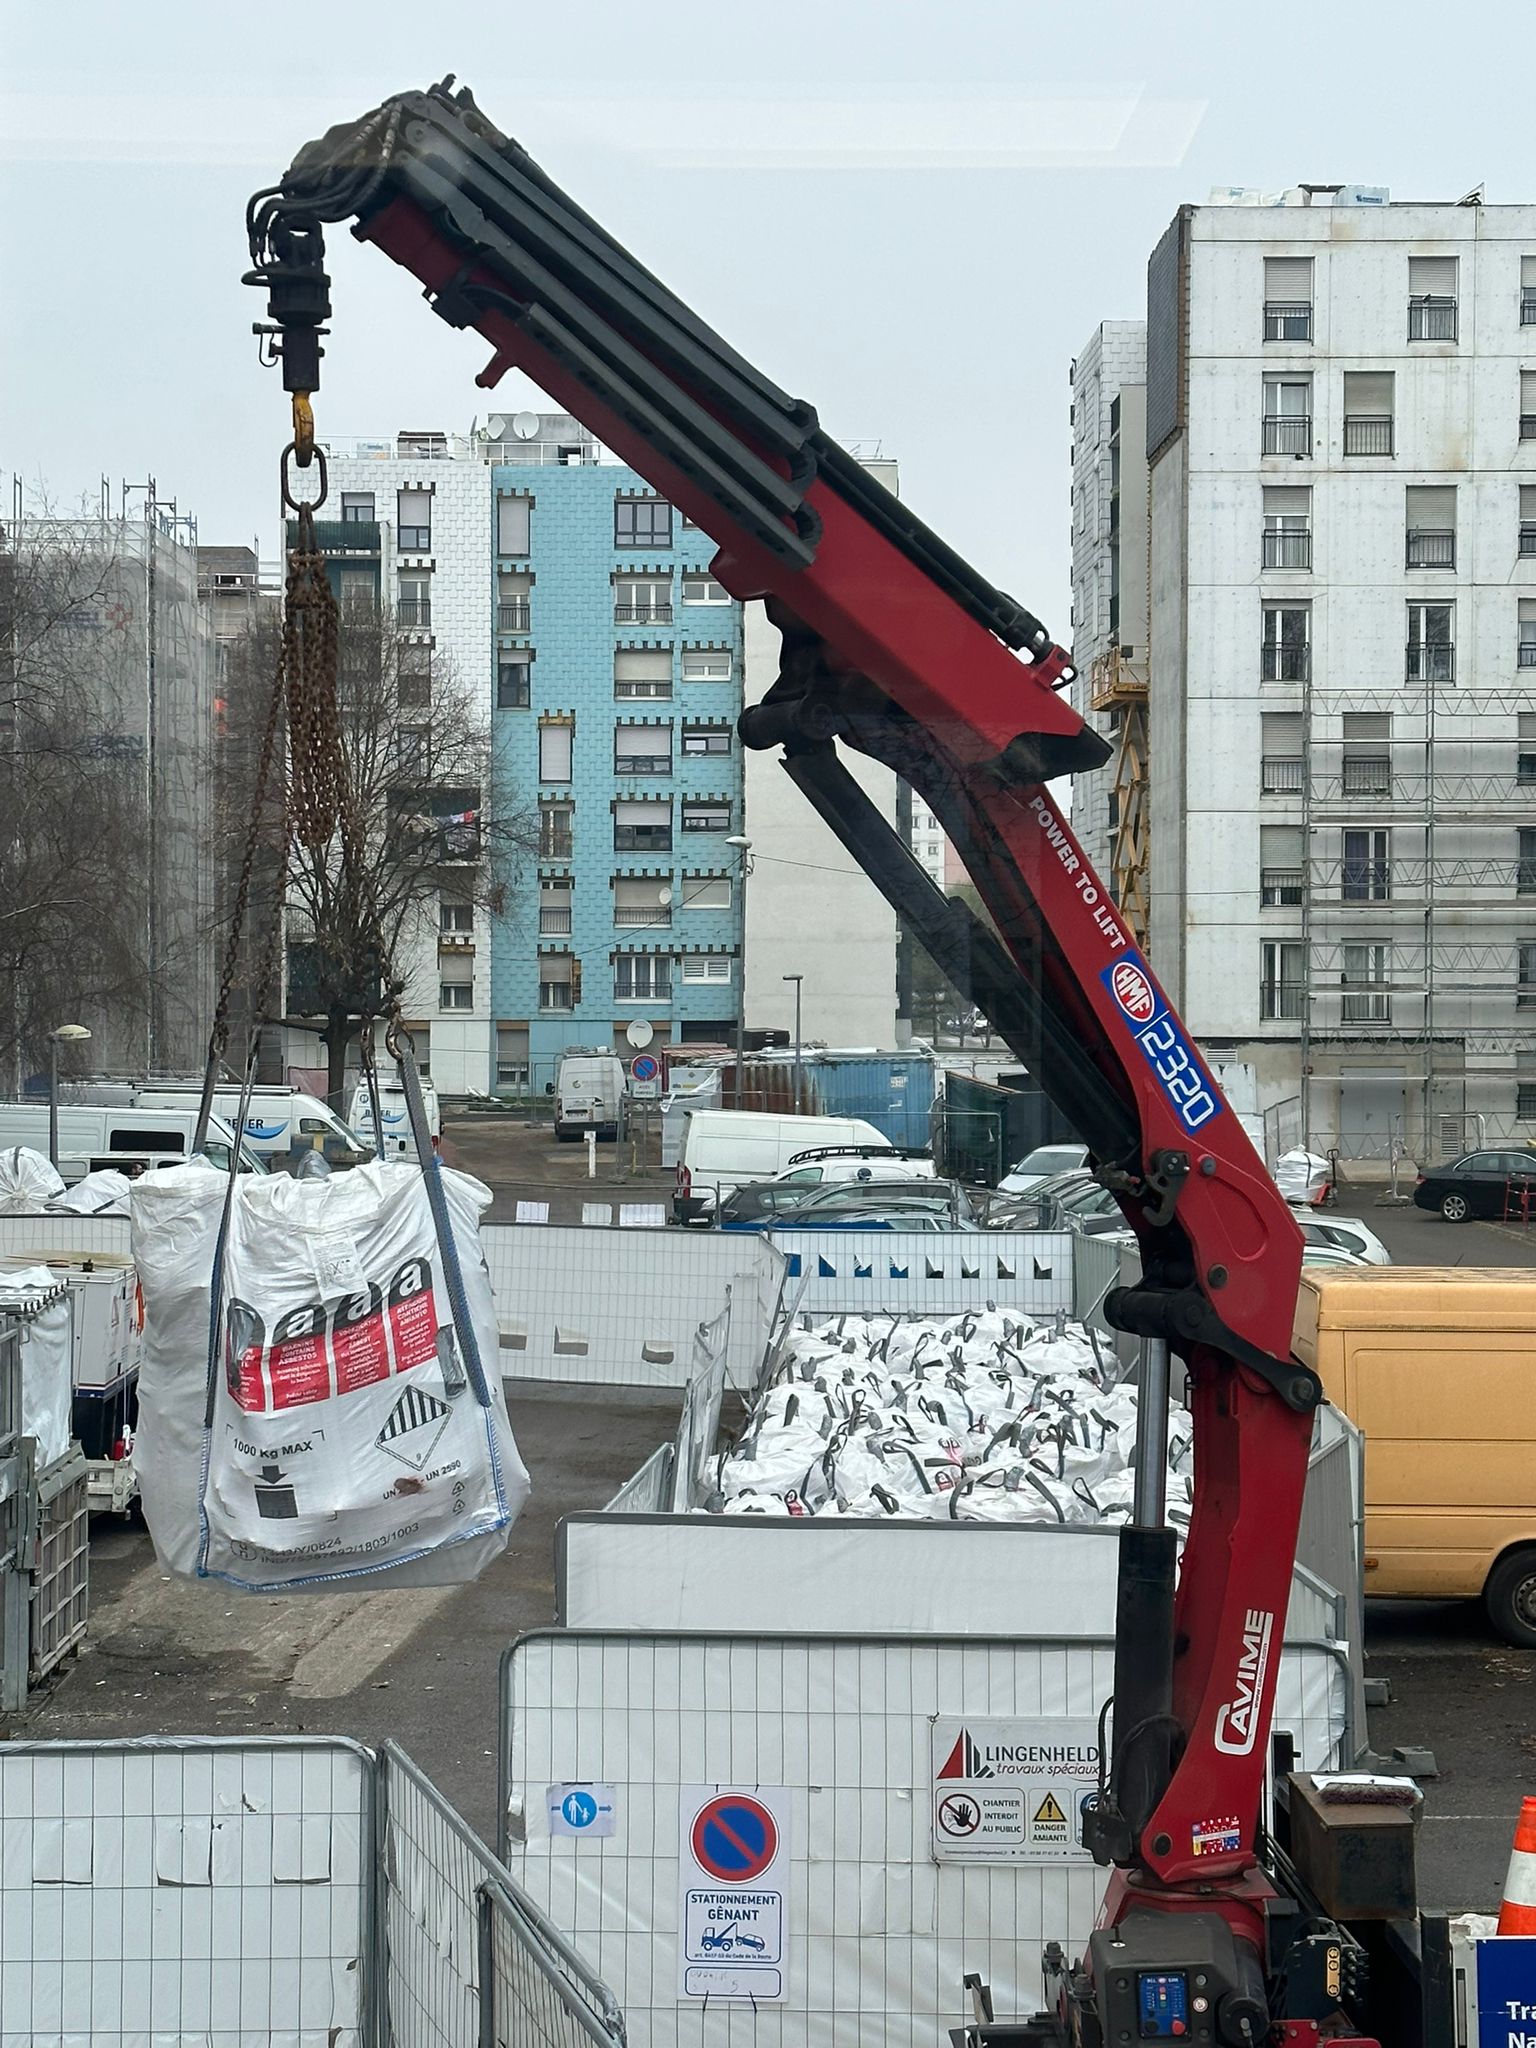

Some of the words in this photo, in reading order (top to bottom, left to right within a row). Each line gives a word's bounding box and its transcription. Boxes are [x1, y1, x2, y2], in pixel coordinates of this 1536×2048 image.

[1029, 796, 1081, 874] POWER
[1074, 872, 1099, 906] TO
[1092, 905, 1127, 949] LIFT
[1116, 968, 1150, 1013] HMF
[1141, 1021, 1214, 1126] 2320
[223, 1118, 264, 1130] BEER
[234, 1438, 256, 1457] 1000
[260, 1449, 279, 1460] Kg
[282, 1441, 313, 1456] MAX
[383, 1489, 396, 1500] UN
[425, 1470, 440, 1481] UN
[441, 1460, 461, 1475] 2590
[1214, 1609, 1274, 1755] CAVIME
[986, 1746, 1099, 1762] LINGENHELD
[996, 1763, 1044, 1775] travaux
[1047, 1762, 1100, 1777] spéciaux
[983, 1799, 1020, 1807] CHANTIER
[984, 1812, 1018, 1820] INTERDIT
[982, 1825, 993, 1833] AU
[995, 1825, 1021, 1833] PUBLIC
[1034, 1824, 1066, 1832] DANGER
[1032, 1834, 1067, 1842] AMIANTE
[691, 1894, 776, 1906] STATIONNEMENT
[708, 1906, 759, 1921] GÊNANT
[1508, 2032, 1536, 2048] Na
